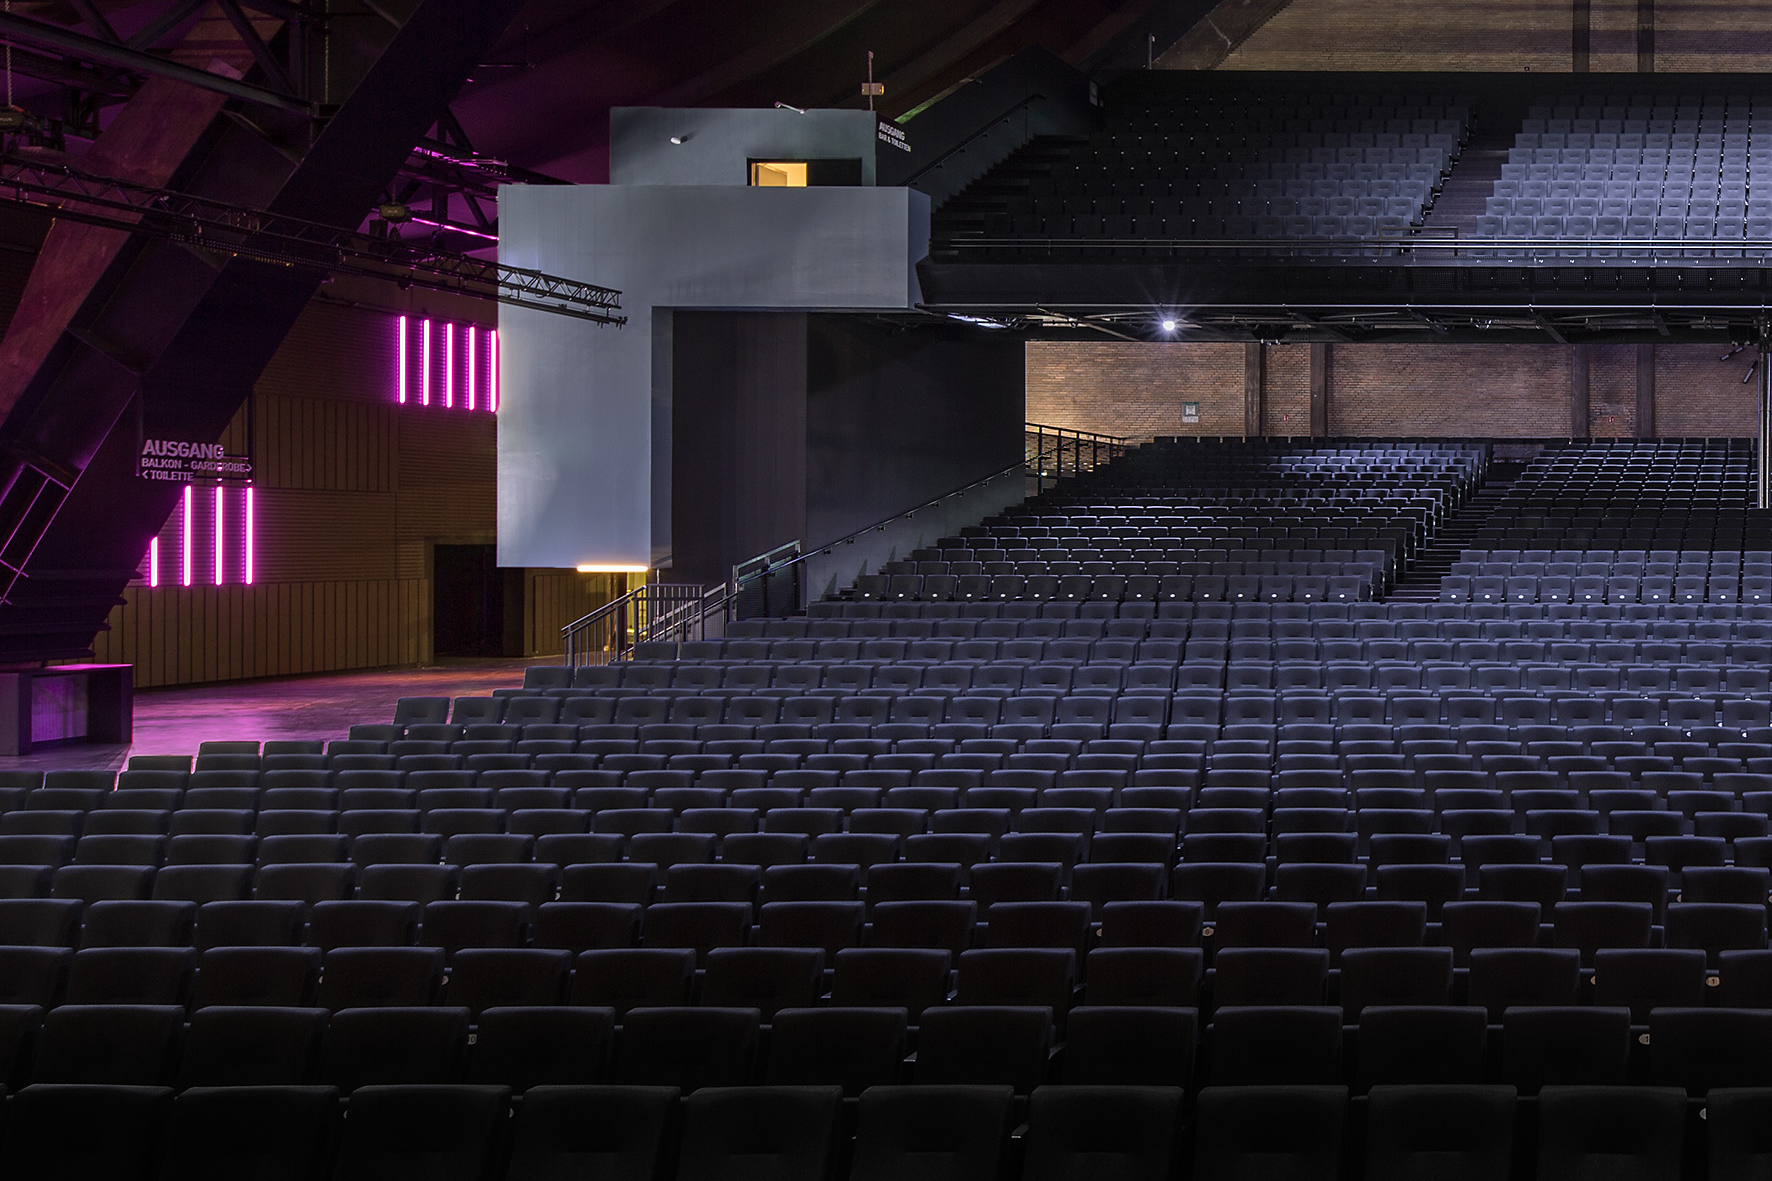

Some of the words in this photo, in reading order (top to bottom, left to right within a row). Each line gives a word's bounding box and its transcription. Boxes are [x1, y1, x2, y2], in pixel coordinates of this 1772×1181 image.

[878, 121, 905, 141] AUSGANG
[142, 439, 224, 459] AUSGANG
[142, 458, 182, 469] BALKON
[190, 460, 247, 473] GARDEROBE
[150, 469, 194, 481] TOILETTE
